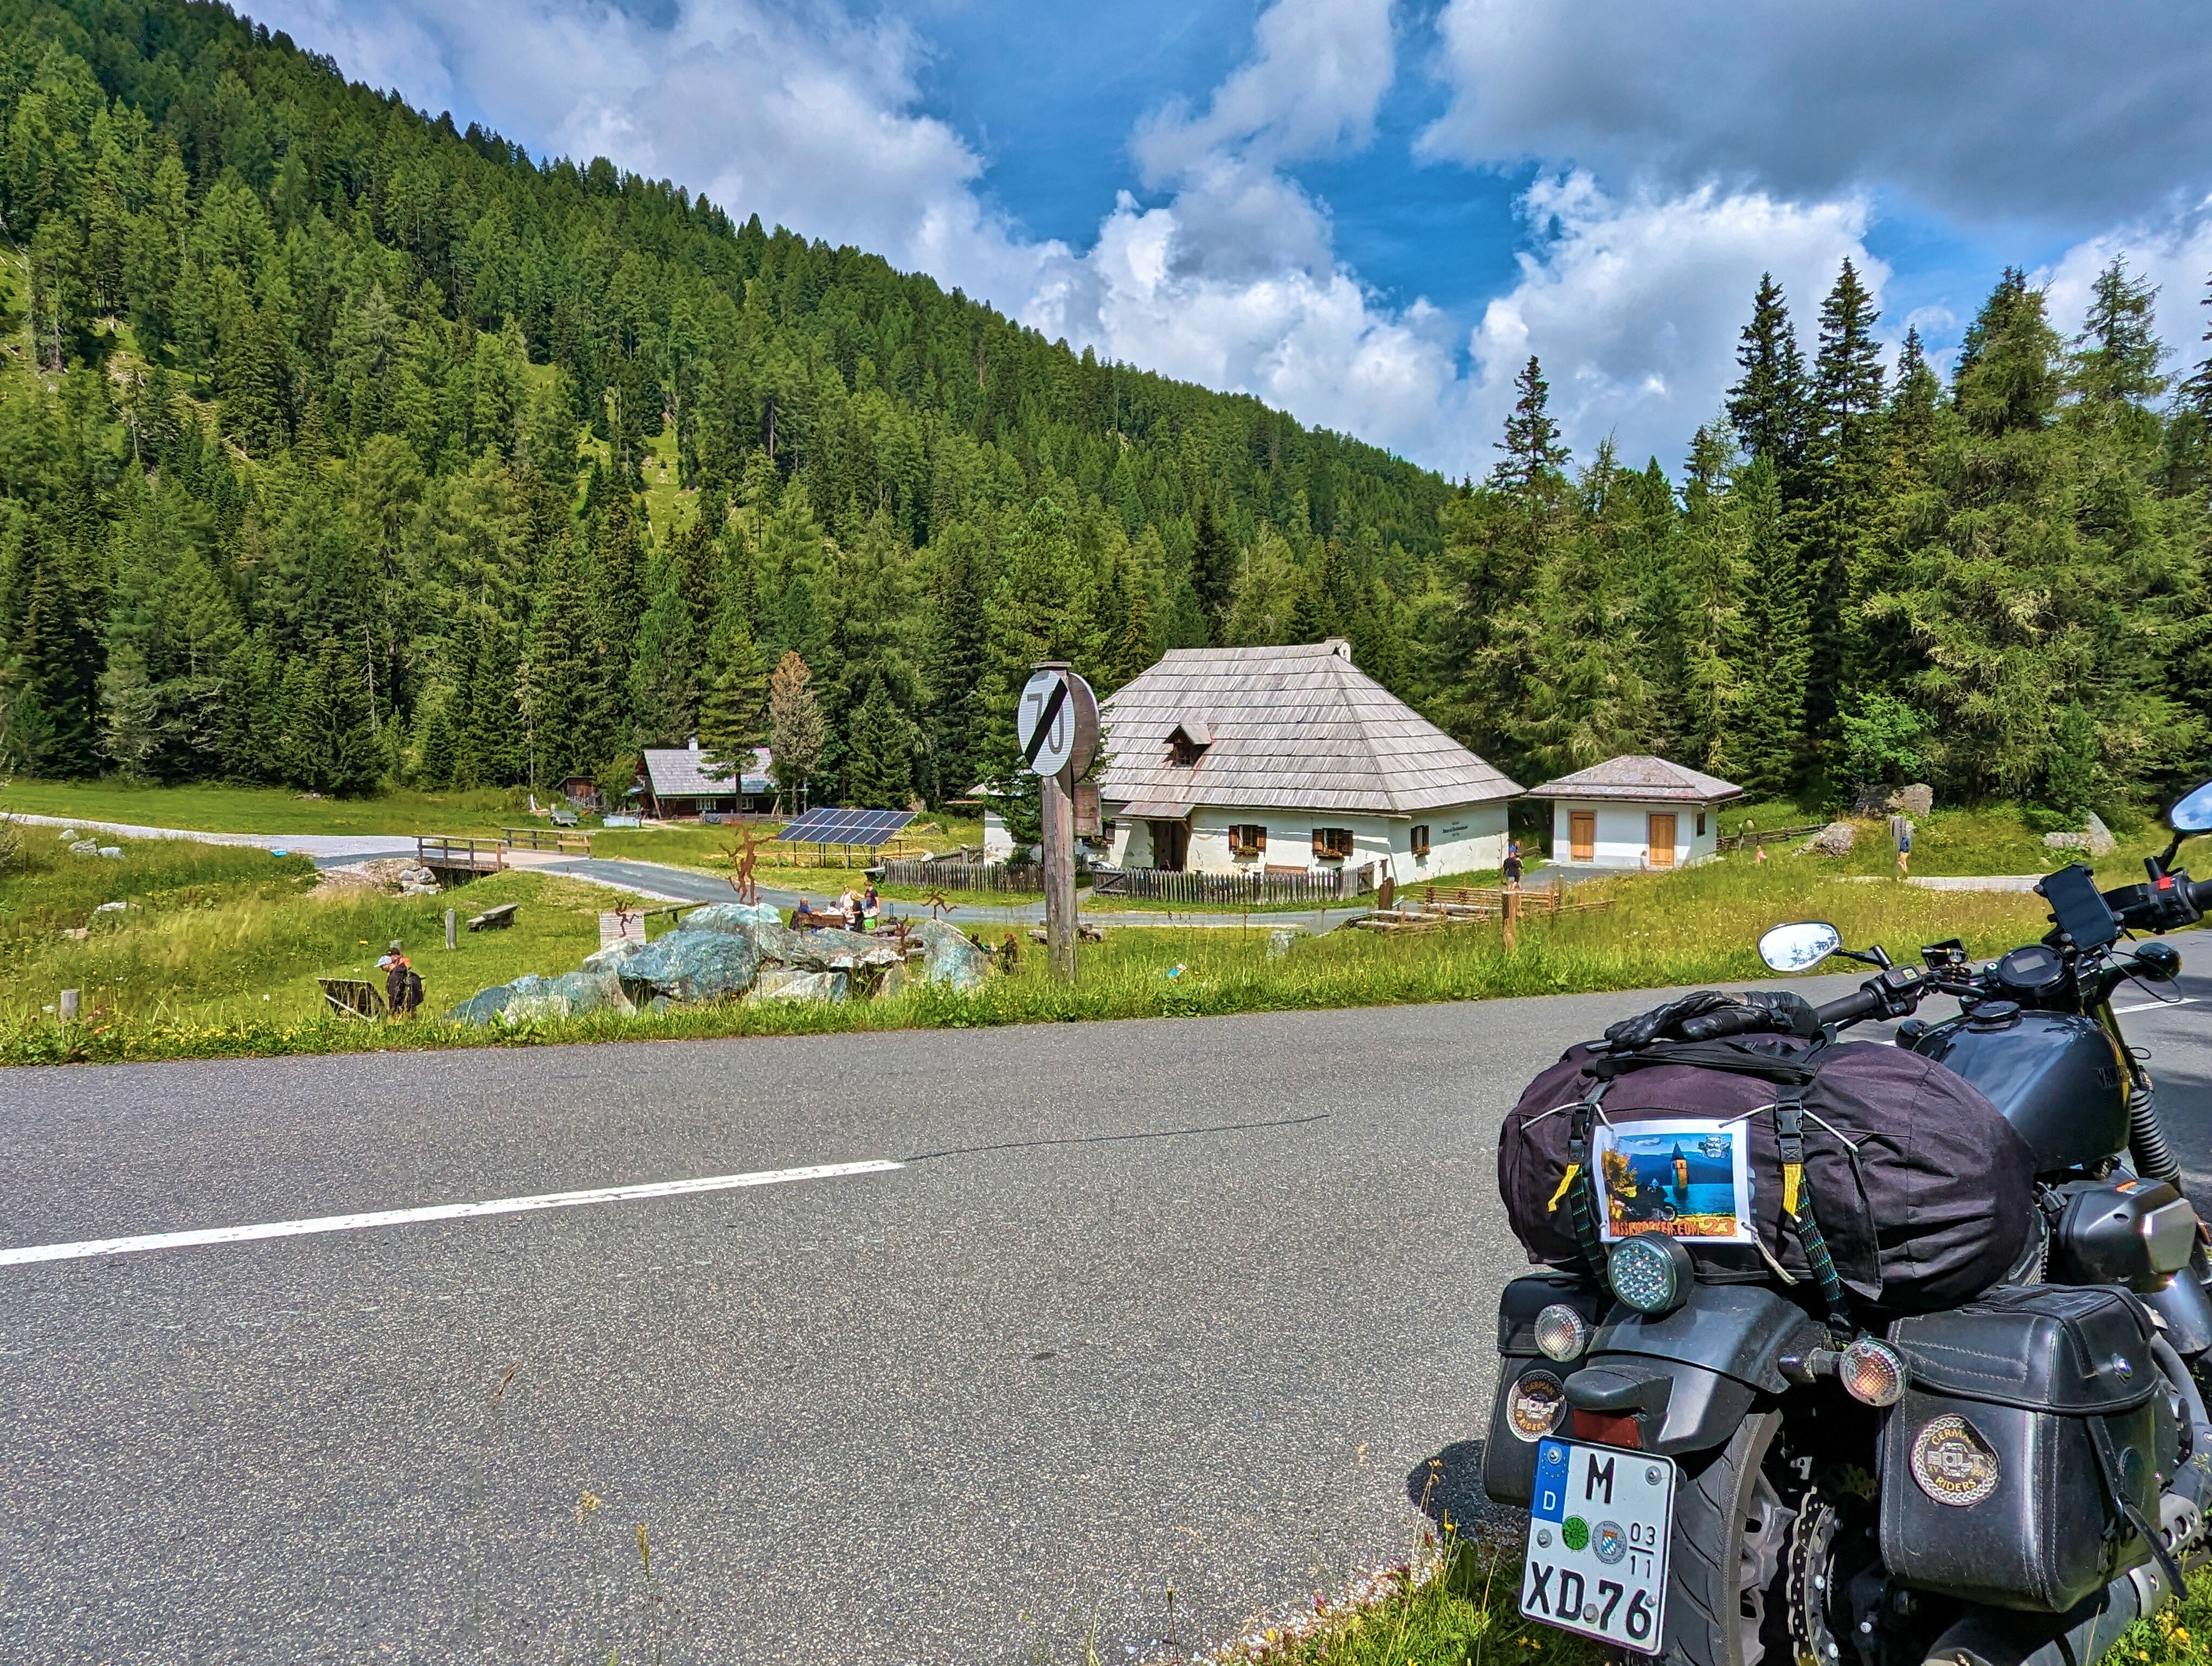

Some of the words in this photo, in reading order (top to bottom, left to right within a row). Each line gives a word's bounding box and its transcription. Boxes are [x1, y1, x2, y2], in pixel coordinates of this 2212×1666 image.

[1027, 691, 1064, 755] 70
[1704, 1218, 1735, 1236] 23
[1586, 1453, 1615, 1504] M
[1935, 1476, 1977, 1492] RIDERS
[1543, 1490, 1556, 1511] D
[1630, 1522, 1656, 1546] 03
[1631, 1554, 1651, 1579] 11
[1526, 1561, 1586, 1621] XD
[1599, 1579, 1651, 1640] 76
